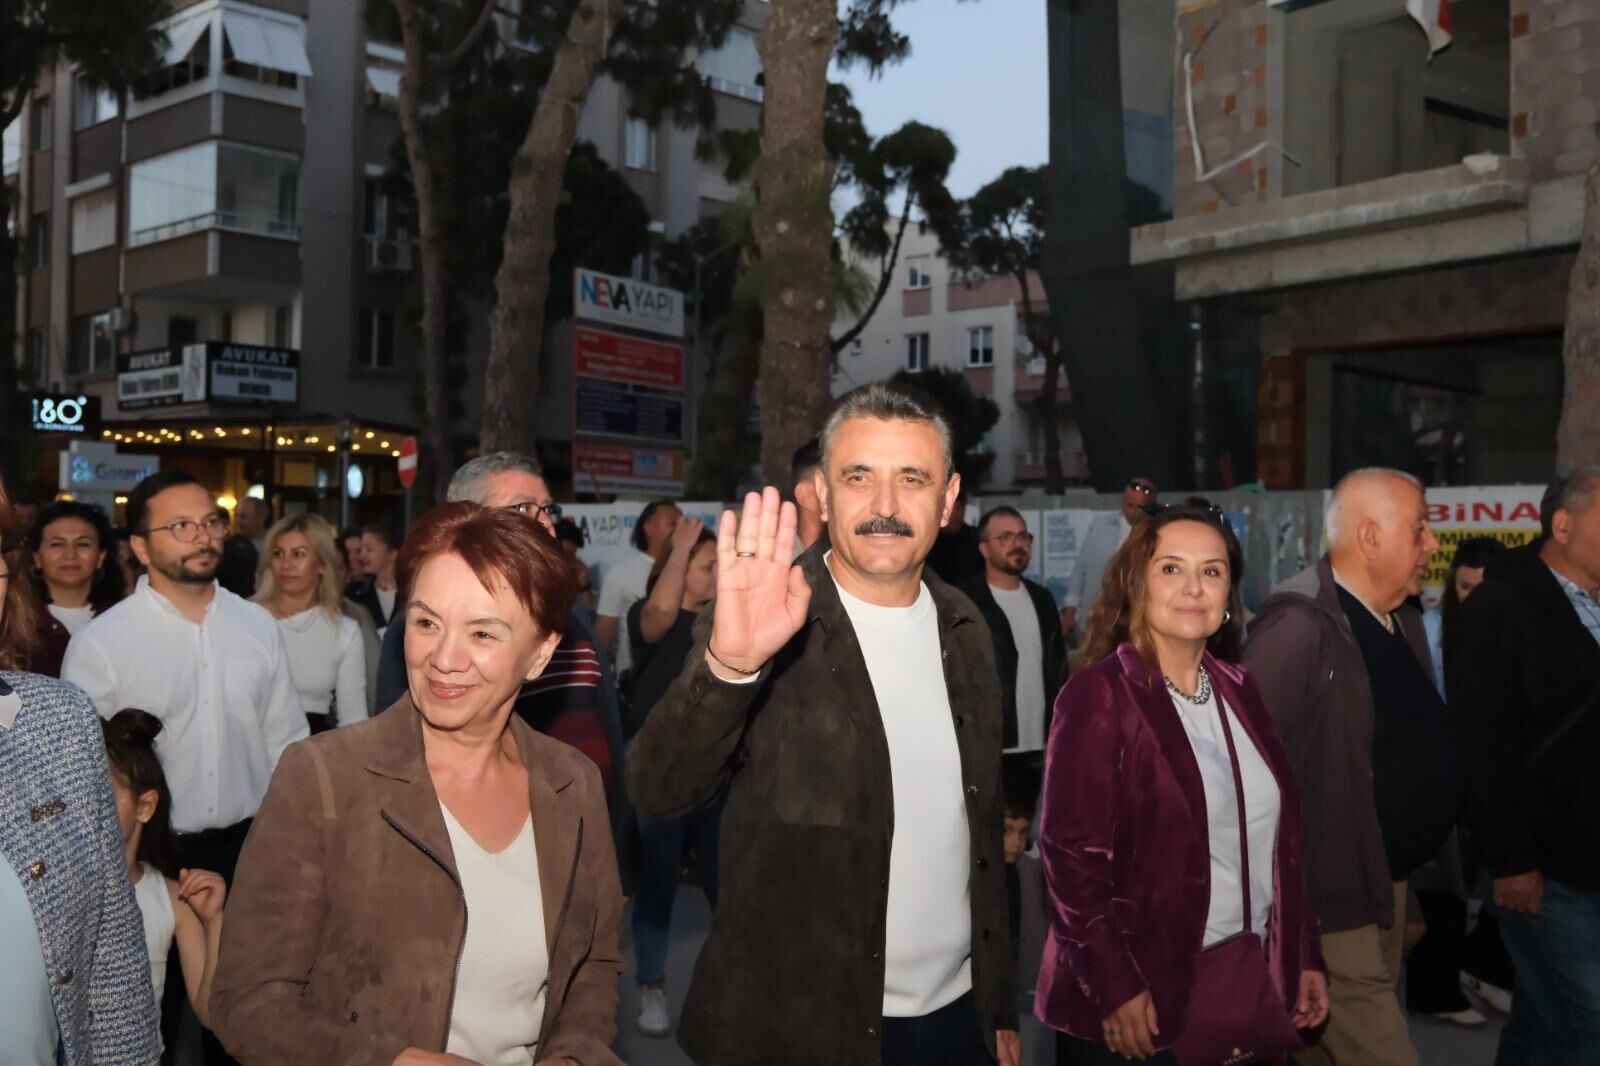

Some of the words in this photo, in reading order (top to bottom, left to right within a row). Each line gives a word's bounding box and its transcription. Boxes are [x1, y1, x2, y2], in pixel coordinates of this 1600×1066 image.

[581, 273, 632, 313] NEVA
[631, 284, 674, 315] YAPI
[129, 352, 171, 369] AVUKAT
[222, 346, 289, 364] AVUKAT
